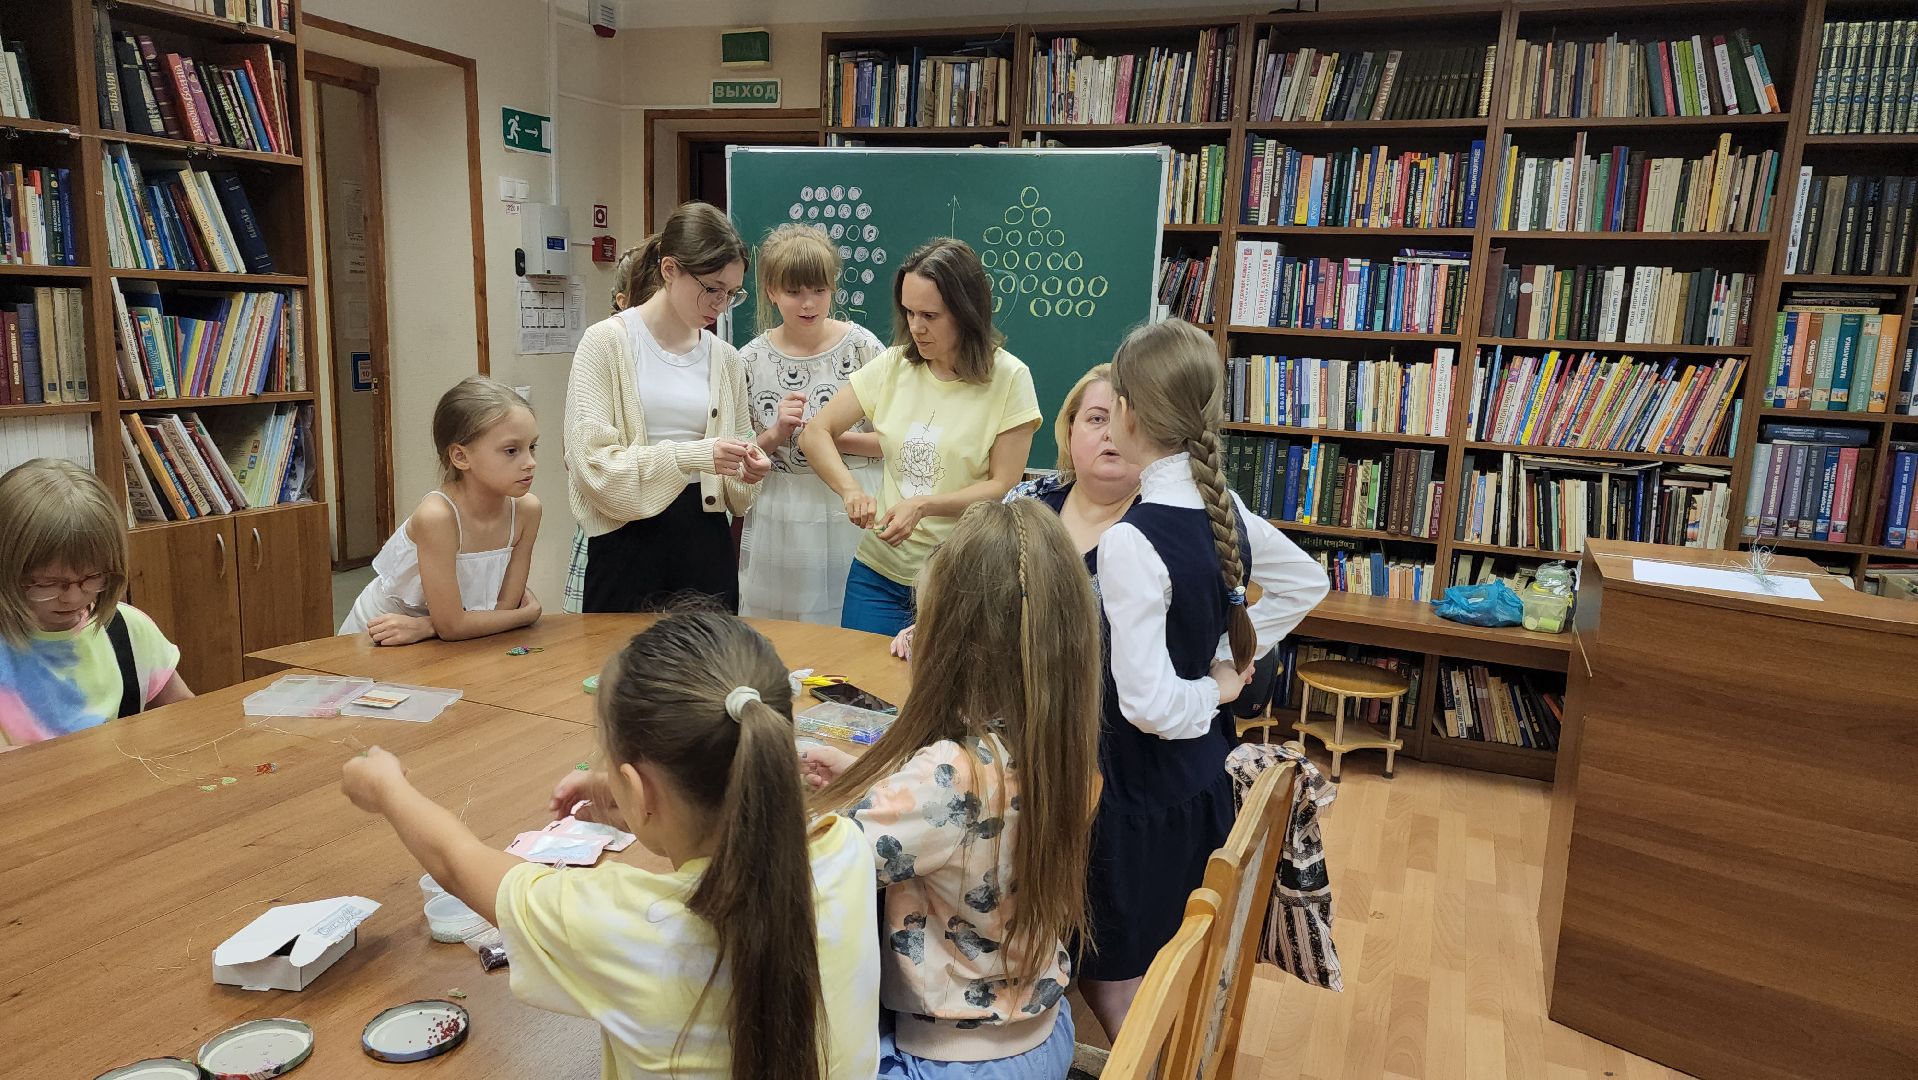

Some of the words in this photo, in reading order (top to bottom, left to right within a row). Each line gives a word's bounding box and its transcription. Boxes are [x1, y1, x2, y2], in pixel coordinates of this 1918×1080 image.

[106, 72, 120, 112] БИБЛИЯ
[714, 84, 777, 100] ВЫХОД
[1840, 336, 1851, 379] МАТЕМАТИКА
